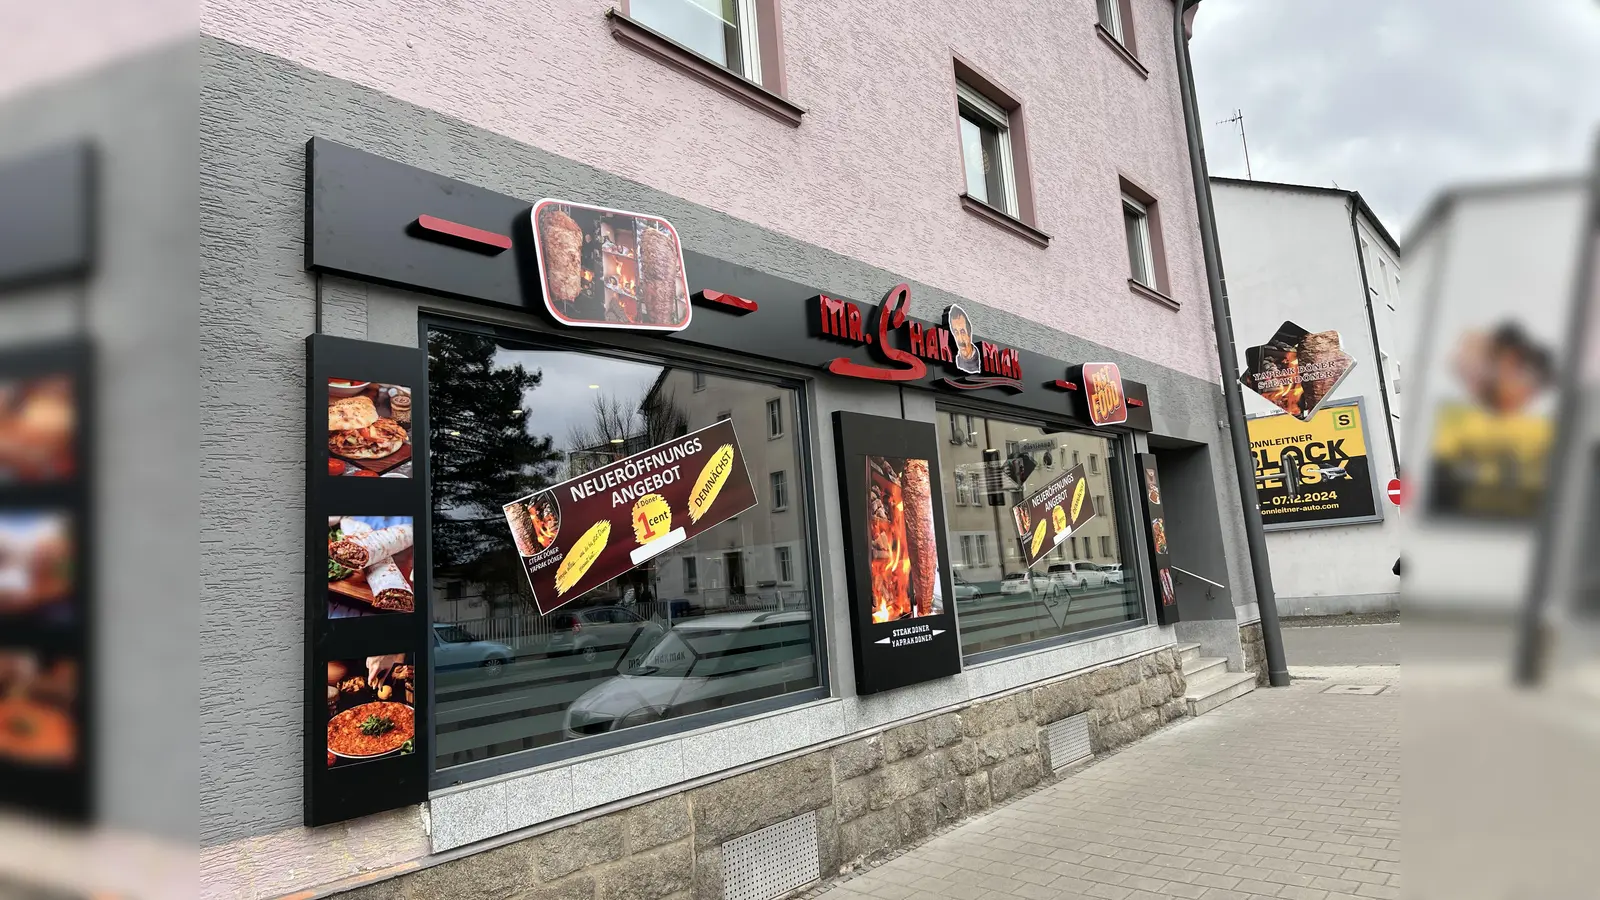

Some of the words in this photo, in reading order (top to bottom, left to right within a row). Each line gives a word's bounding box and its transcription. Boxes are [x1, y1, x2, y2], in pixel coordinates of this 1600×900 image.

[819, 294, 872, 344] MR.
[981, 340, 1022, 380] MAK
[1252, 367, 1295, 381] YAPRAK
[1257, 378, 1293, 390] STEAK
[1092, 380, 1120, 422] FOOD
[1338, 414, 1350, 426] S
[570, 437, 703, 502] NEUERÖFFNUNGS
[612, 465, 681, 508] ANGEBOT
[694, 451, 731, 507] DEMNÄCHST
[1031, 472, 1074, 508] NEUERÖFFNUNGS
[1044, 489, 1068, 512] ANGEBOT
[637, 511, 656, 540] 1
[649, 510, 669, 526] cent
